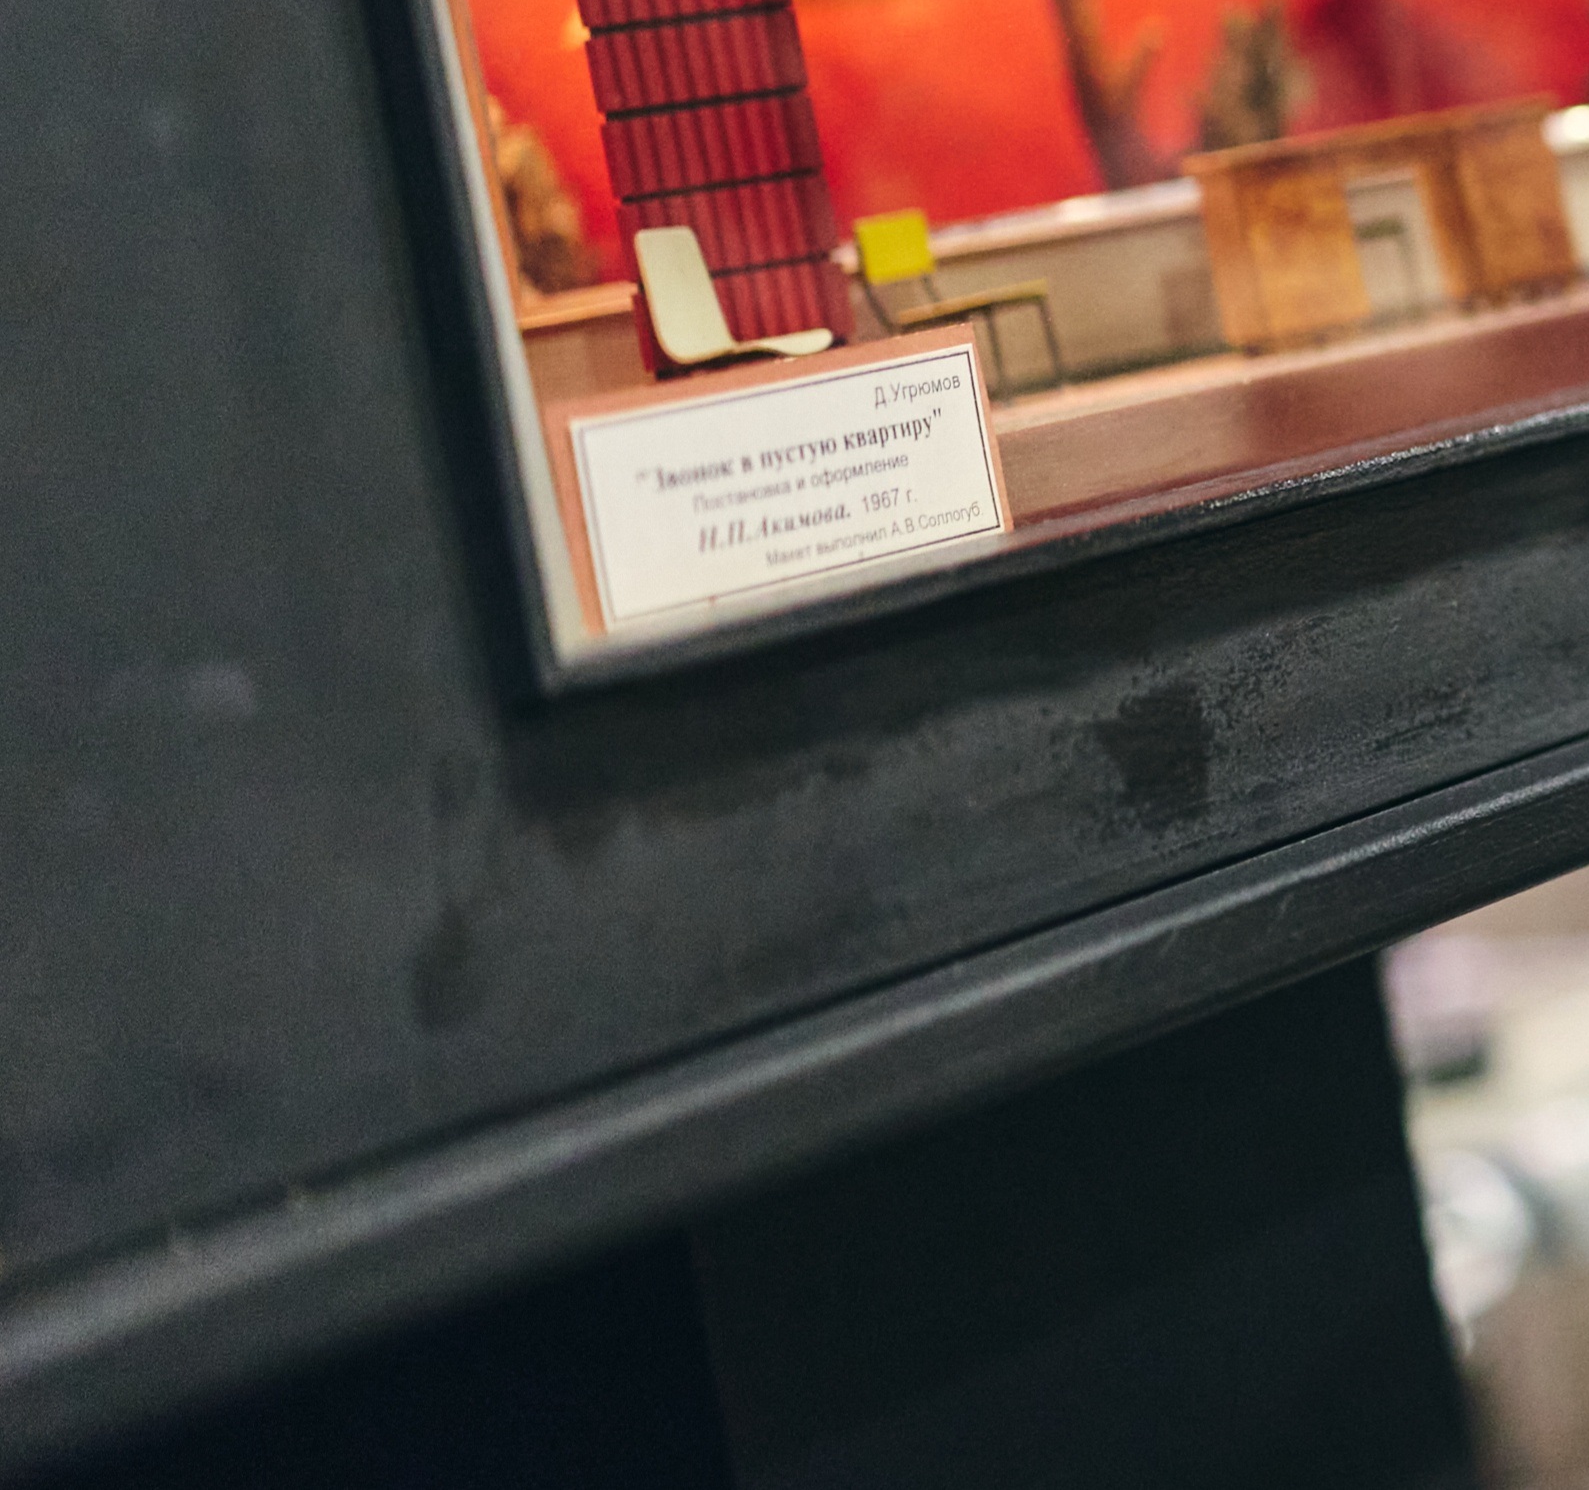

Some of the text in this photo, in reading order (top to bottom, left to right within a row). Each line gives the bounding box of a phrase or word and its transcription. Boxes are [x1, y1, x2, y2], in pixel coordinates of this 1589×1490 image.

[874, 375, 961, 408] Д.Угрюмов
[741, 455, 752, 472] в
[760, 437, 837, 471] пустую
[843, 408, 941, 450] квартиру"
[693, 454, 909, 513] Постановка и оформление
[862, 488, 899, 512] 1967
[906, 489, 918, 503] г.
[766, 545, 811, 566] Макет
[815, 527, 887, 555] выполнил
